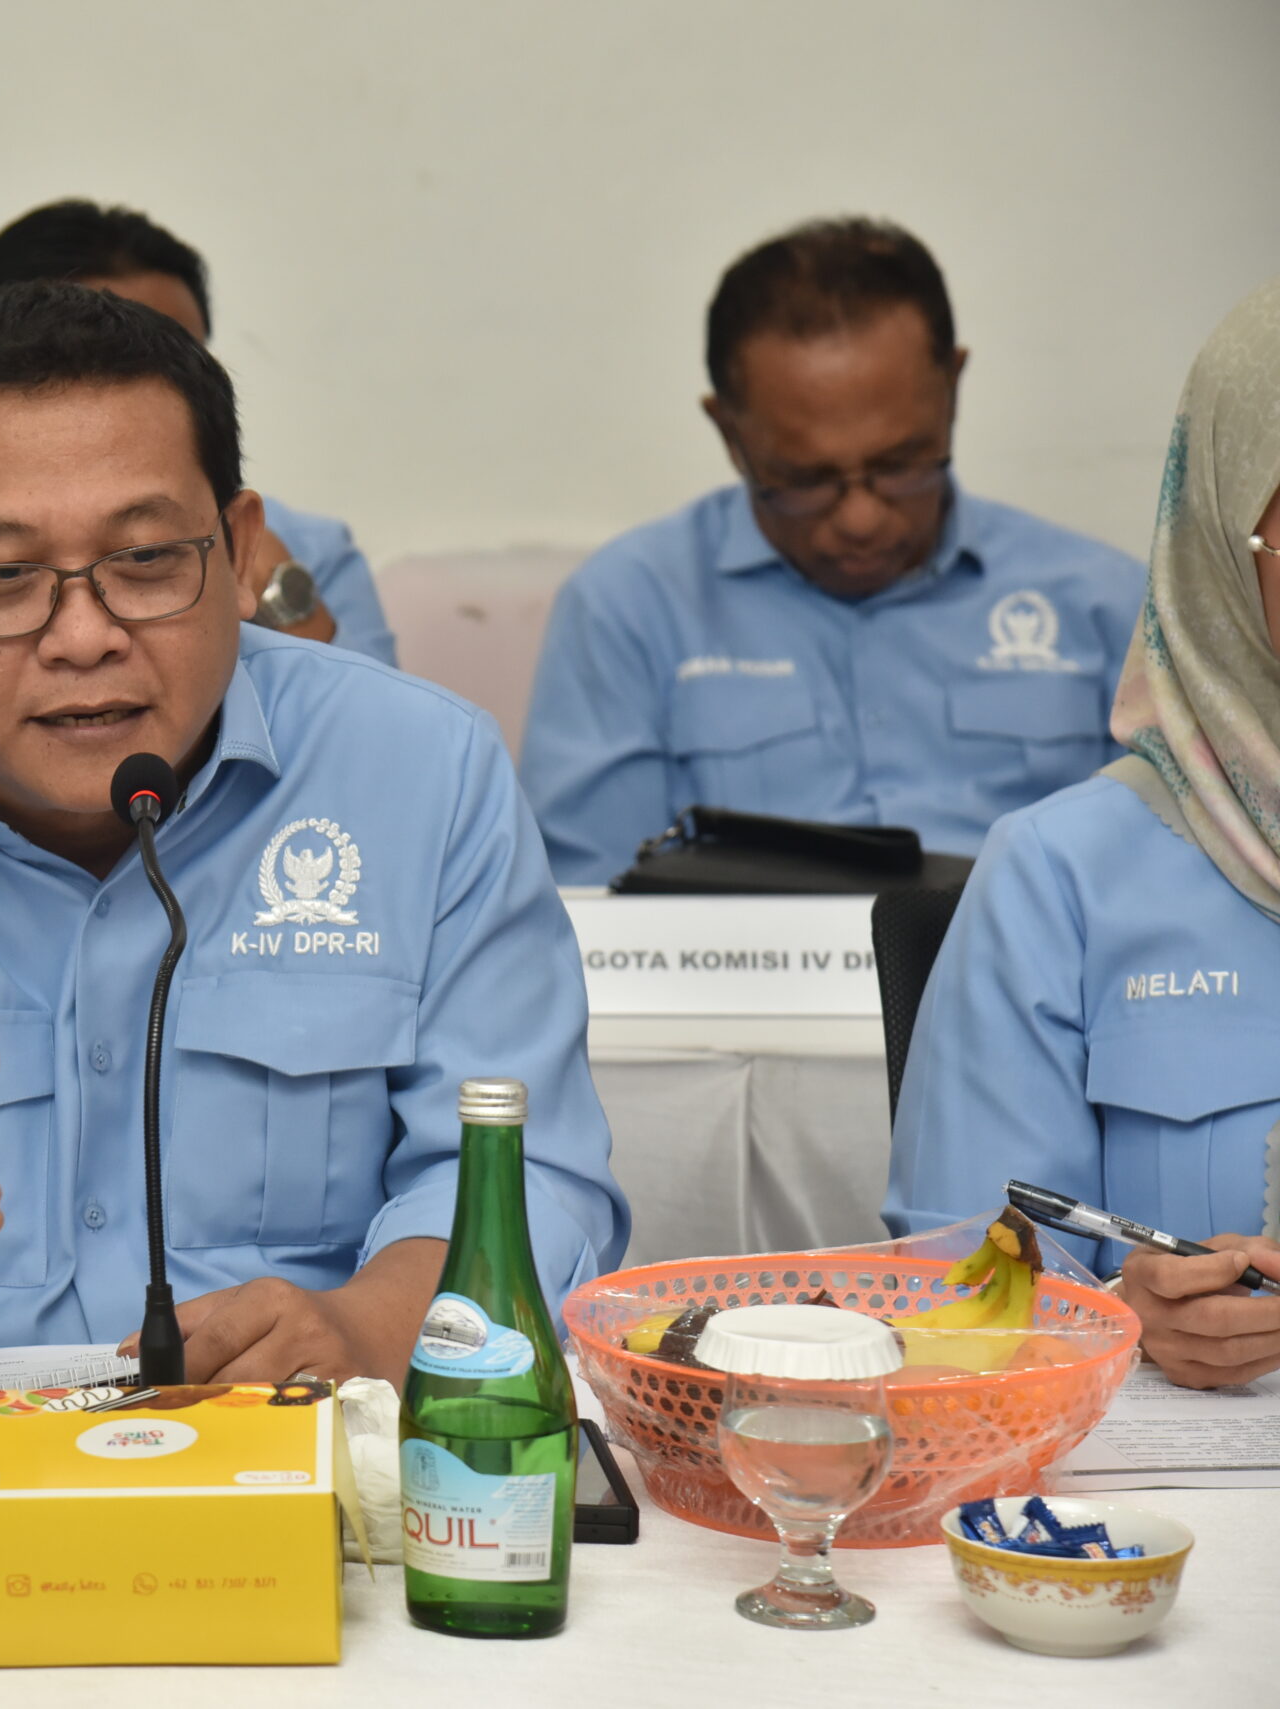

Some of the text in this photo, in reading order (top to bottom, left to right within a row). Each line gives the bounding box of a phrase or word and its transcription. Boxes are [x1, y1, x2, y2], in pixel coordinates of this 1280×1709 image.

[231, 931, 380, 957] K-IV DPR-RI
[586, 949, 669, 971] GOTA
[679, 949, 789, 970] KOMISI
[801, 950, 832, 970] IV
[1126, 970, 1239, 1000] MELATI
[403, 1507, 499, 1549] QUIL
